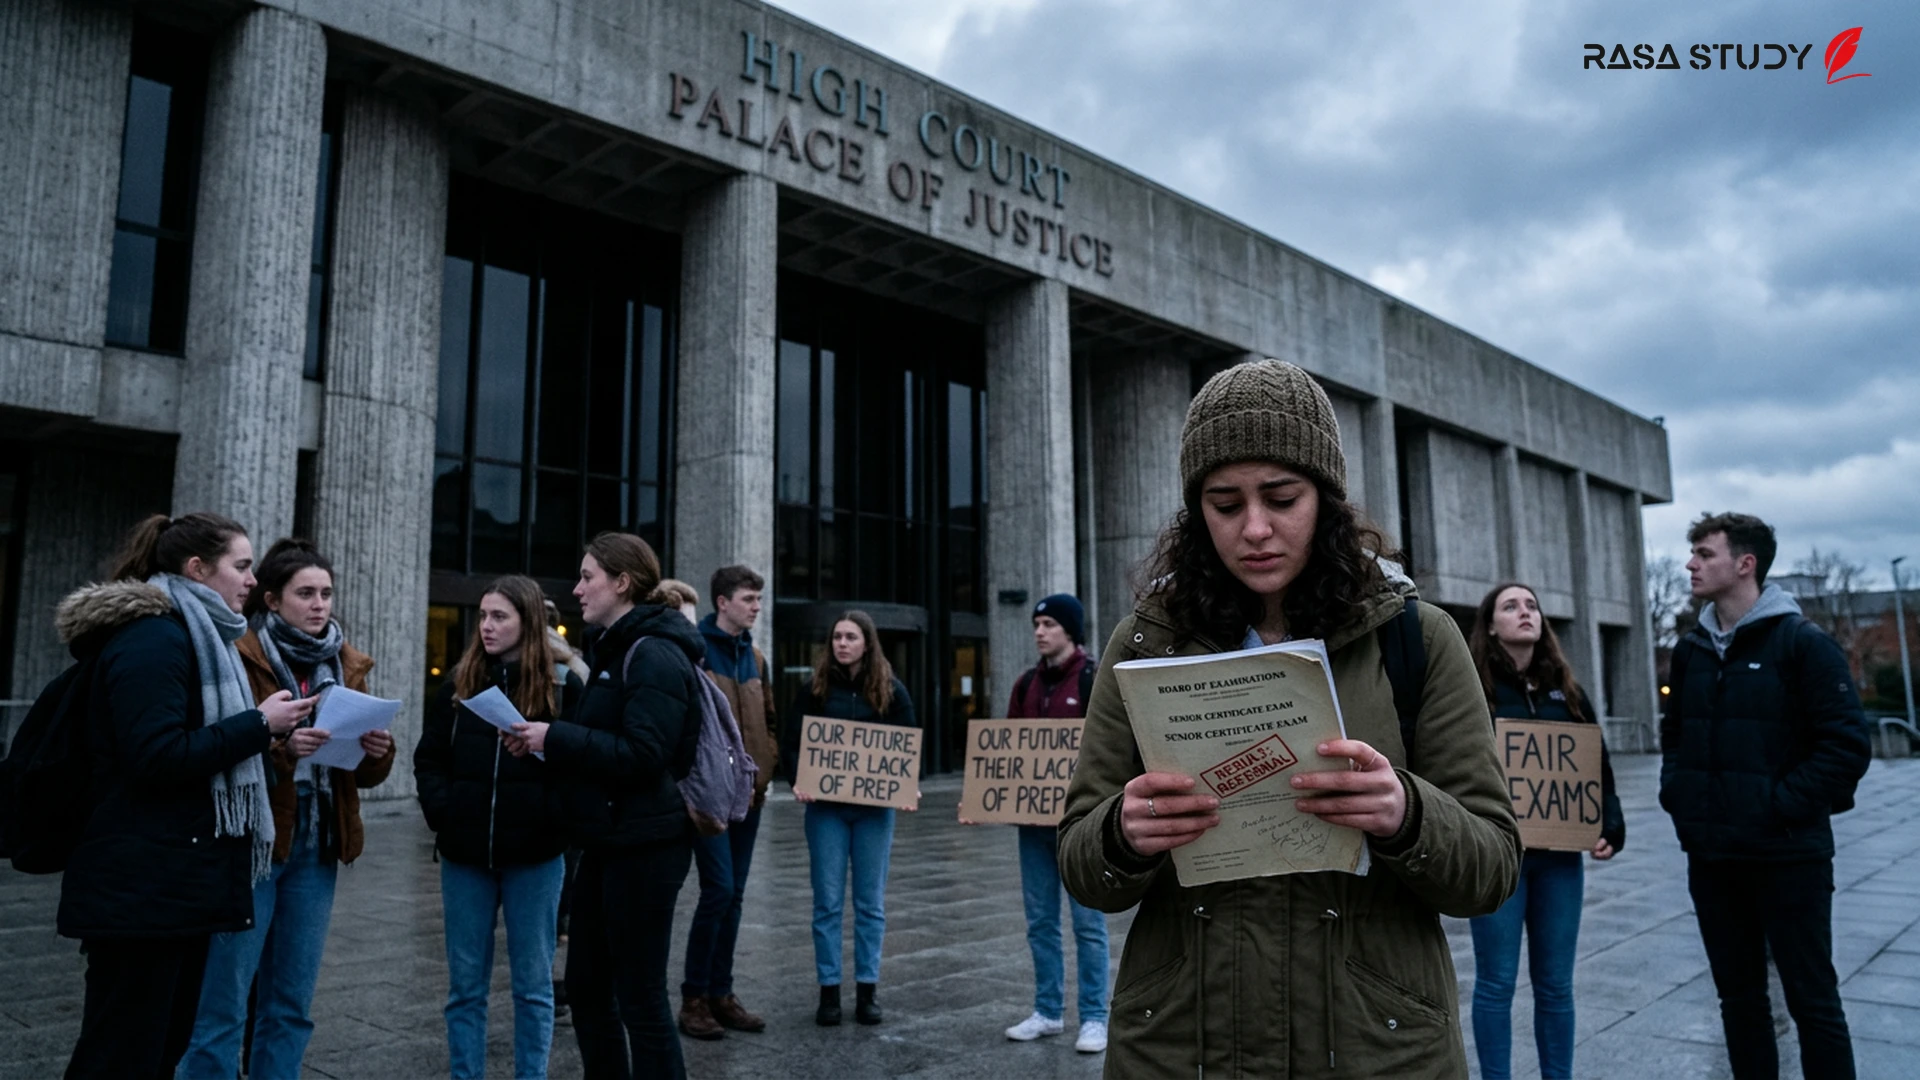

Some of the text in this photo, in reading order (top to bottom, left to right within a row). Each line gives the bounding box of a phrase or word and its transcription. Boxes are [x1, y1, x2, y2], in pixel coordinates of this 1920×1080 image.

[741, 30, 1071, 208] HIGH COURT
[669, 72, 1115, 278] PALACE OF JUSTICE
[807, 721, 917, 755] OUR FUTURE.
[978, 727, 1081, 750] OUR FUTURE
[1505, 731, 1578, 772] FAIR
[807, 747, 912, 778] THEIR LACK
[972, 757, 1079, 780] THEIR LACK
[820, 774, 900, 800] OF PREP
[982, 785, 1065, 814] OF PREP
[1508, 777, 1600, 825] EXAMS
